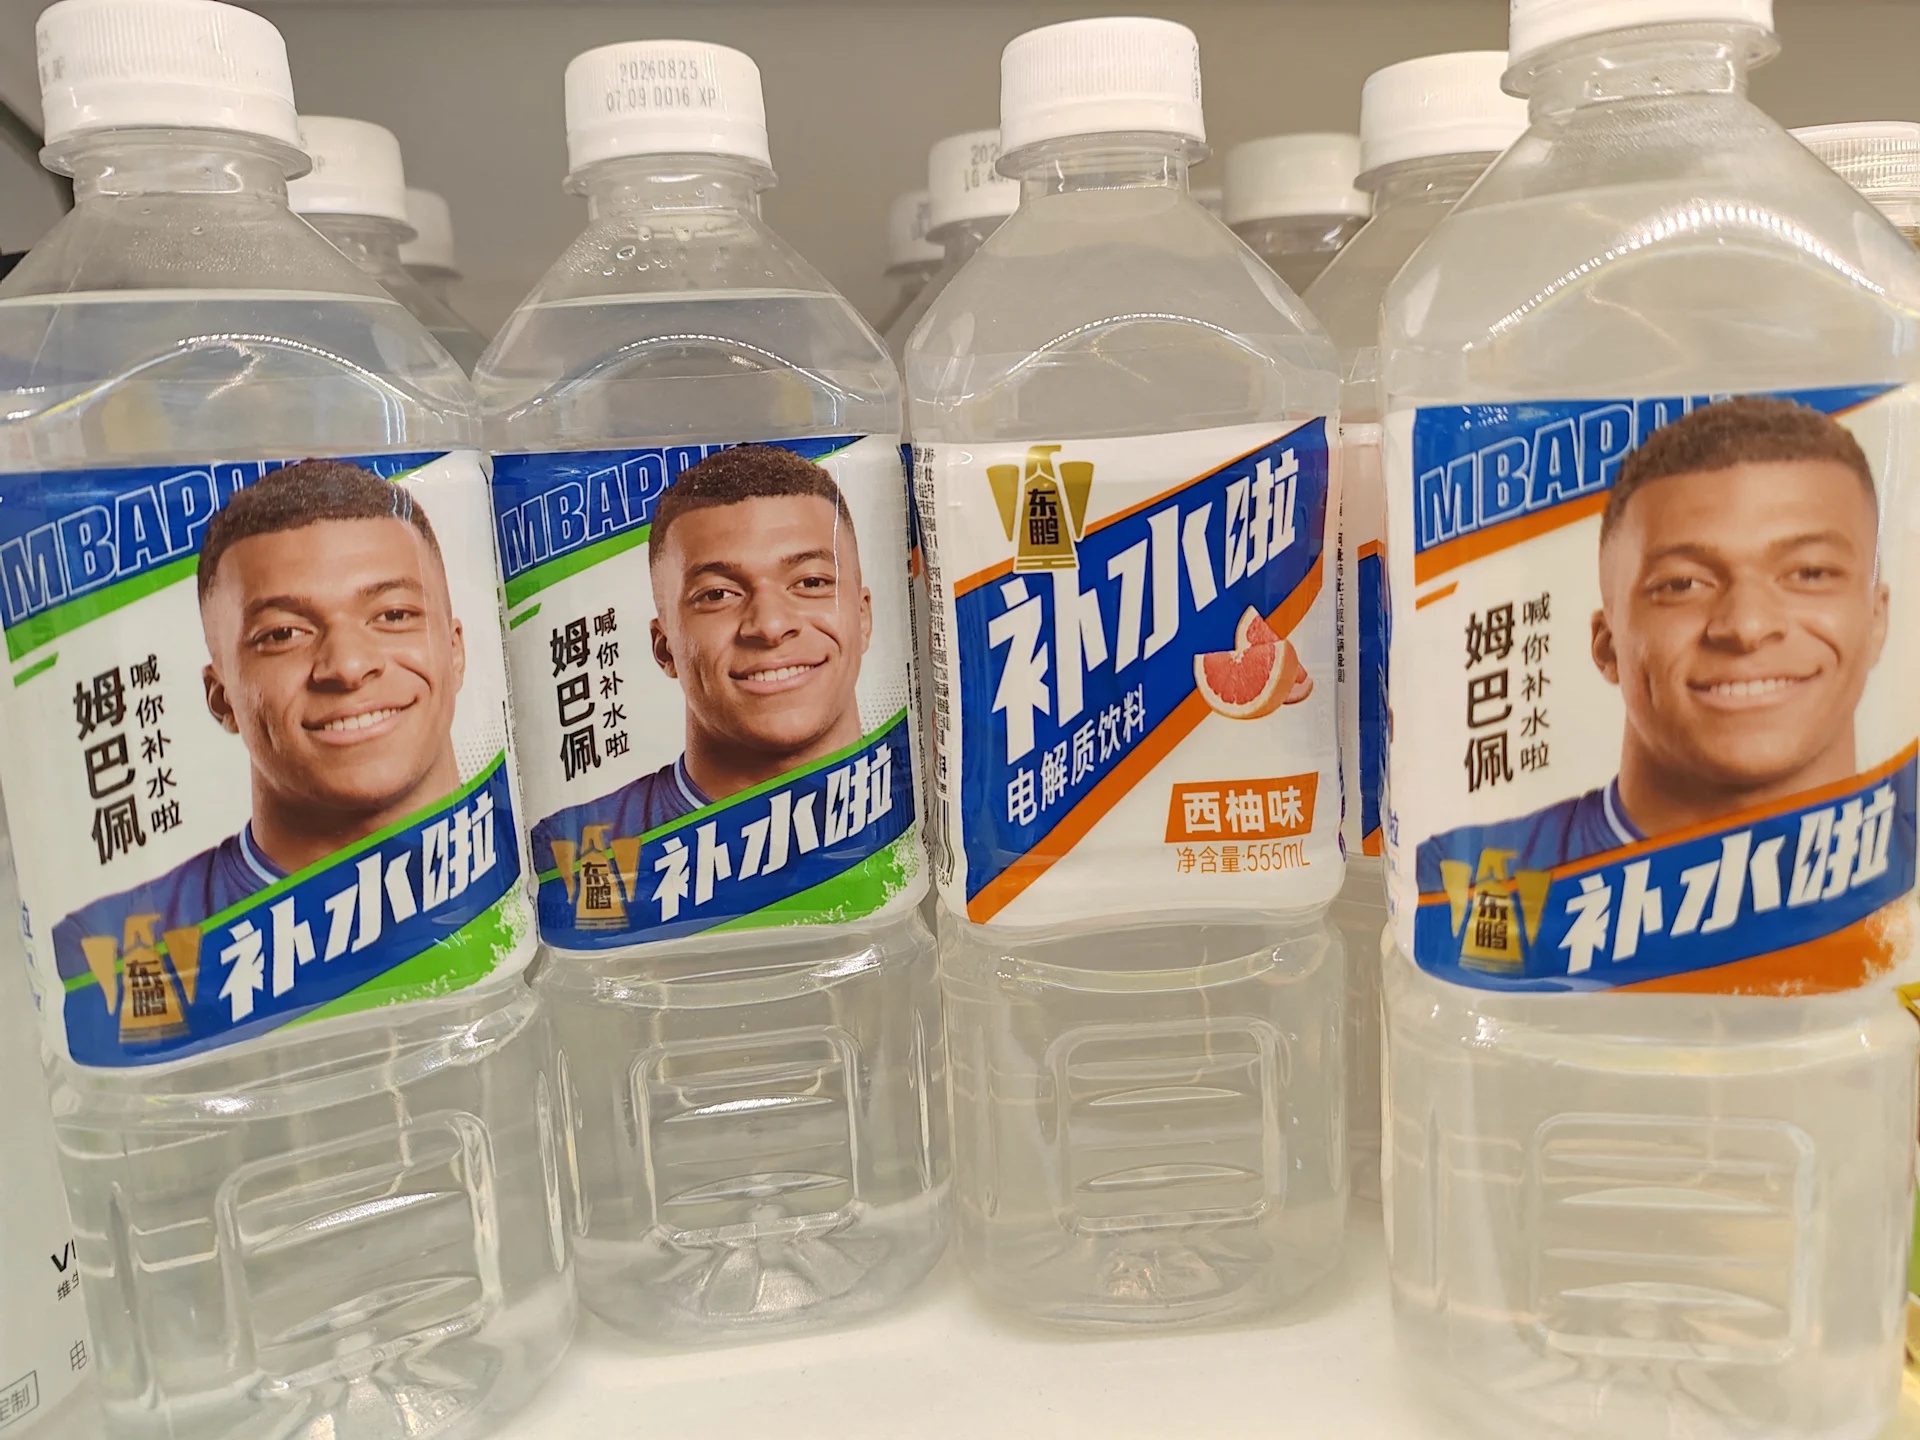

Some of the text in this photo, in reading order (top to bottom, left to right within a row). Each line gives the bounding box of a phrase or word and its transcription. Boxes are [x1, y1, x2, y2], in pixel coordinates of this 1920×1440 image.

[619, 59, 698, 83] 20260825
[654, 86, 691, 108] 0016
[698, 86, 717, 108] XP
[0, 459, 302, 623] MBAP
[501, 443, 742, 576] MBAP
[1028, 488, 1060, 546] 东鹏
[1420, 395, 1735, 549] MBAP
[987, 448, 1300, 765] 补水啦
[1519, 591, 1552, 773] 喊你补水啦
[130, 655, 183, 835] 喊你补水啦
[549, 616, 601, 783] 姆巴佩
[592, 607, 631, 761] 喊你补水啦
[1006, 683, 1147, 827] 电解质饮料
[1464, 599, 1516, 795] 姆巴佩
[73, 666, 147, 866] 姆巴佩
[652, 742, 893, 922] 补水啦
[1181, 784, 1305, 834] 西柚味
[217, 797, 498, 1023] 补水啦
[582, 860, 612, 911] 东鹏
[1176, 838, 1311, 874] 净含量:555mL
[1475, 890, 1509, 951] 东鹏
[1558, 786, 1898, 975] 补水啦
[125, 957, 168, 1018] 东鹏
